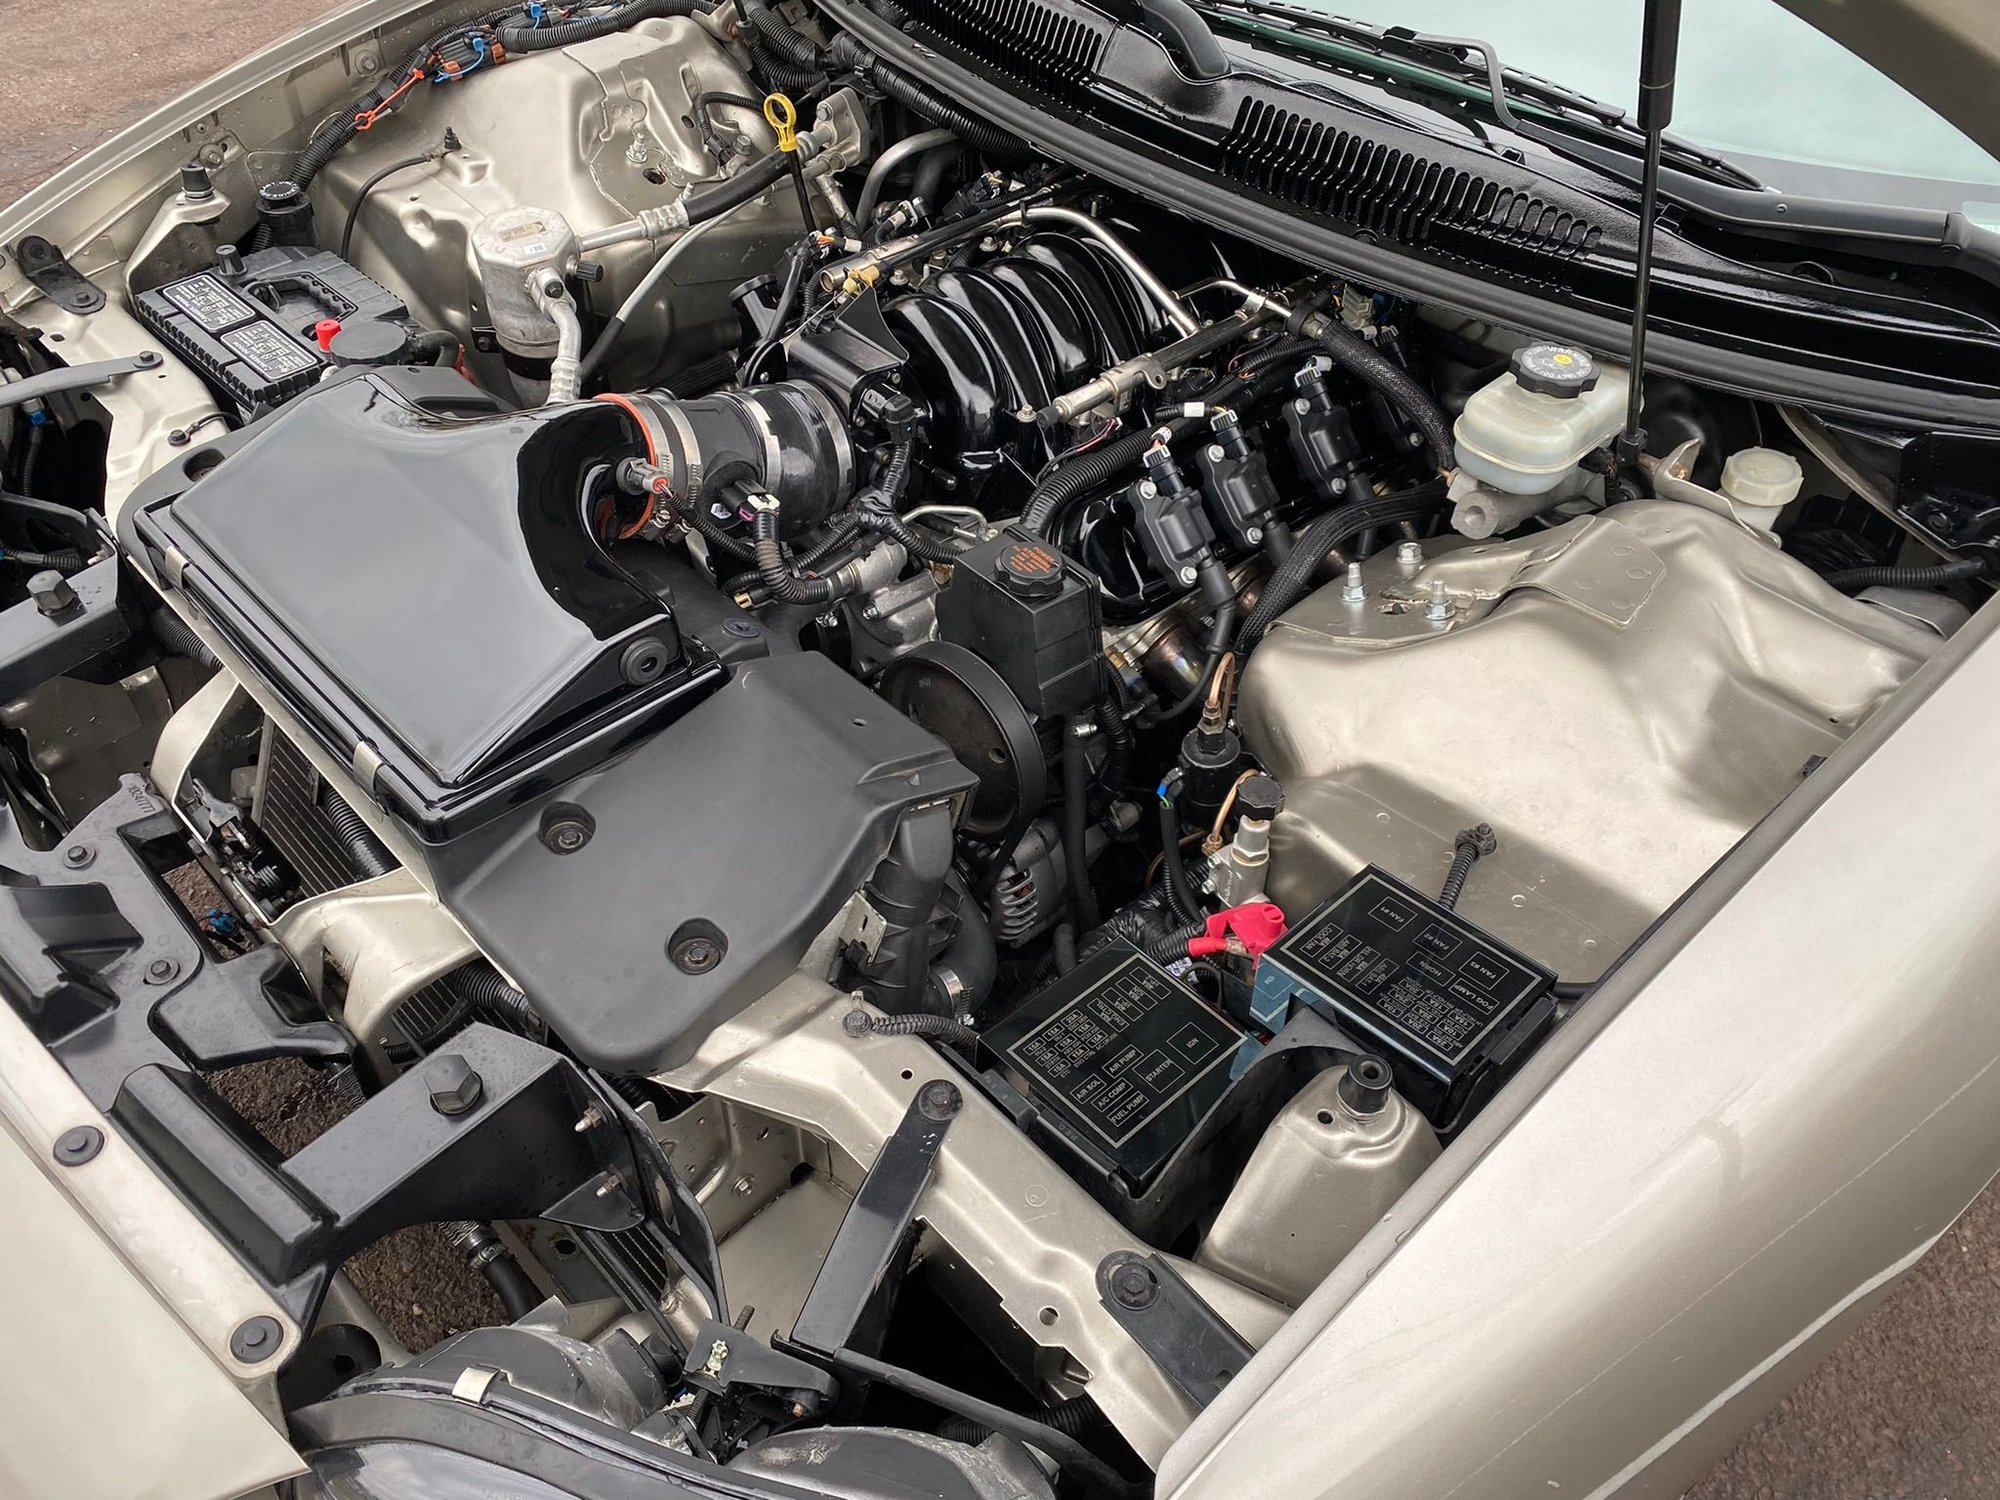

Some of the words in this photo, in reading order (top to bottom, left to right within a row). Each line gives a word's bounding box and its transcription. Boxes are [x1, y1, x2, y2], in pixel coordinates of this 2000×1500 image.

[1388, 911, 1405, 922] FAN
[1423, 932, 1434, 941] #2
[1304, 938, 1318, 949] FAN
[1432, 938, 1449, 950] FAN
[1418, 960, 1442, 976] HORN
[1469, 960, 1481, 969] #3
[1479, 966, 1496, 979] FAN
[1132, 986, 1144, 996] IGN
[1453, 982, 1477, 999] LAMP
[1382, 1002, 1397, 1013] 10A
[1475, 996, 1494, 1009] FOG
[1406, 1018, 1422, 1029] 20A
[1442, 1024, 1457, 1035] 10A
[1059, 1037, 1072, 1047] 10A
[1185, 1037, 1199, 1048] IGN
[1430, 1034, 1447, 1046] 25A
[1107, 1062, 1121, 1073] AIR
[1118, 1048, 1138, 1064] PUMP
[1052, 1062, 1066, 1073] 10A
[1144, 1058, 1173, 1081] STARTER
[1075, 1088, 1088, 1099] AIR
[1085, 1078, 1101, 1090] SOL
[1096, 1095, 1110, 1107] A/C
[1107, 1081, 1127, 1098] COMP
[1110, 1107, 1129, 1123] FUEL
[1125, 1094, 1145, 1110] PUMP
